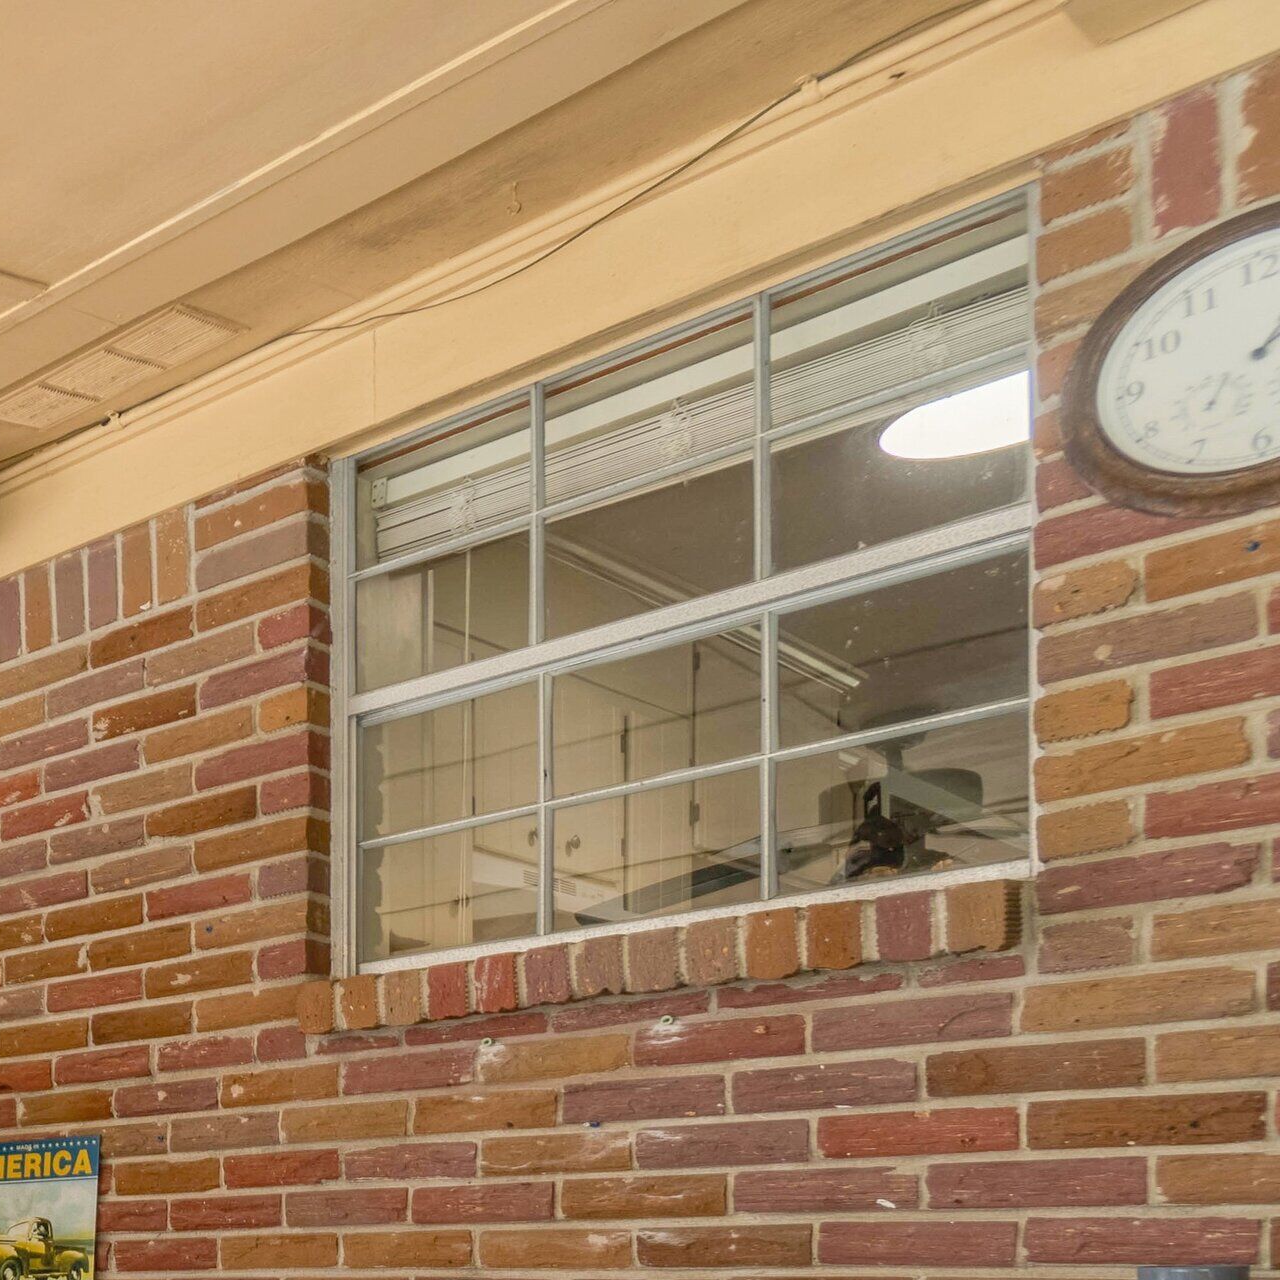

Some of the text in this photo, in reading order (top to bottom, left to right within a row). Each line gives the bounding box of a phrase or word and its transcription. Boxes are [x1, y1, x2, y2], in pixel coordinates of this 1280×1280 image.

[1241, 252, 1280, 288] 12
[1183, 288, 1218, 319] 11
[1142, 329, 1181, 361] 10
[1126, 380, 1145, 405] 9
[1143, 420, 1160, 440] 8
[1252, 425, 1273, 453] 6
[1189, 438, 1207, 464] 7
